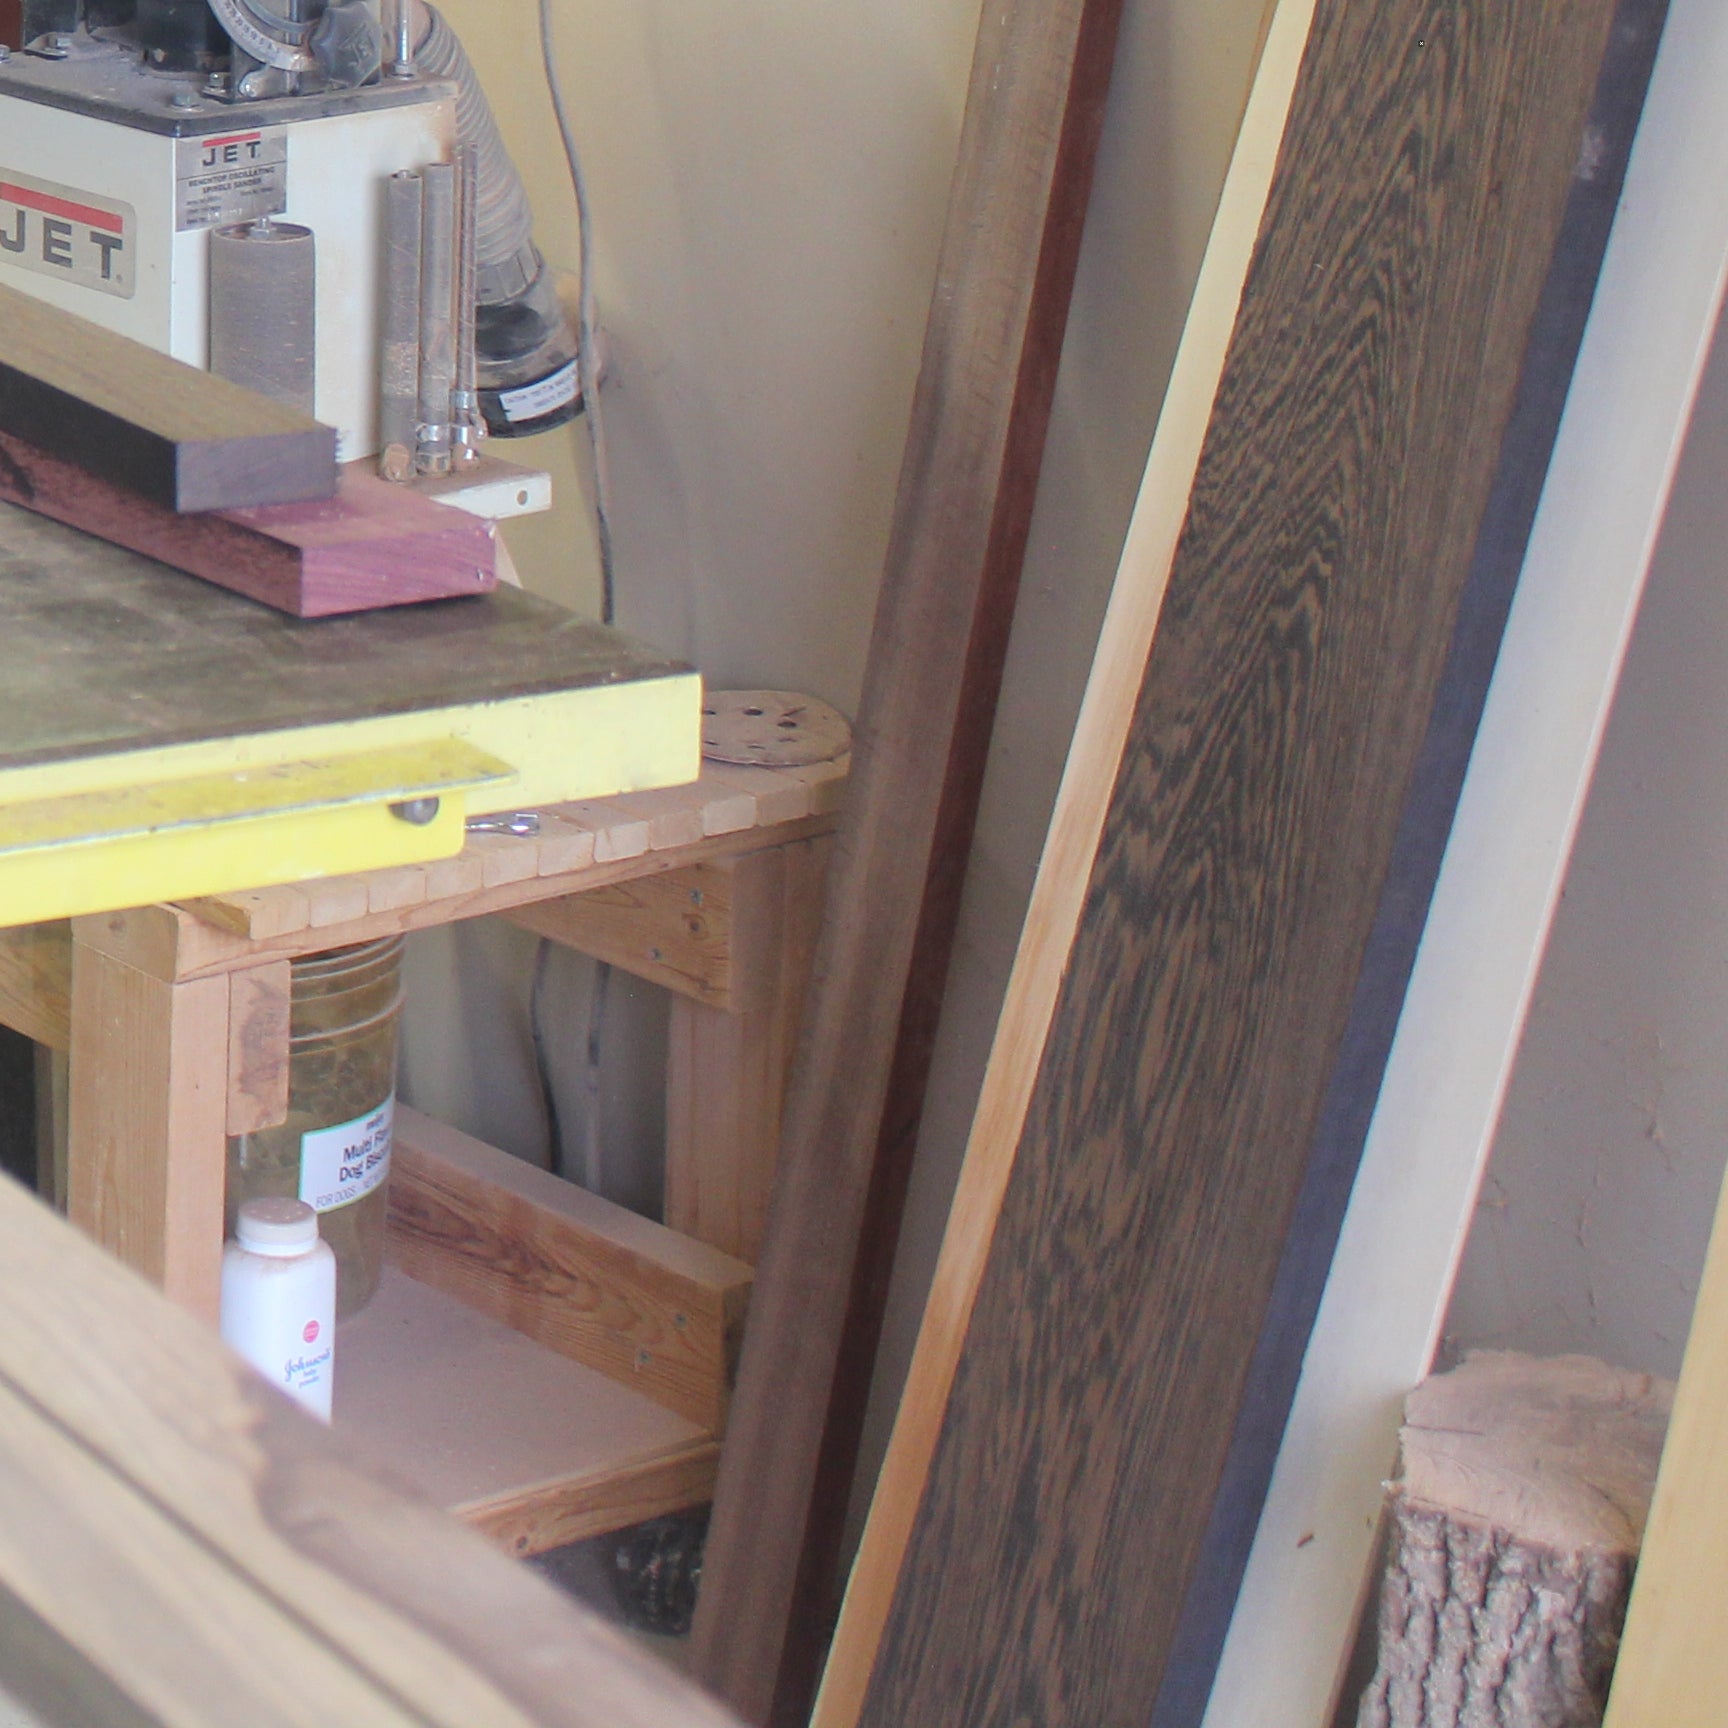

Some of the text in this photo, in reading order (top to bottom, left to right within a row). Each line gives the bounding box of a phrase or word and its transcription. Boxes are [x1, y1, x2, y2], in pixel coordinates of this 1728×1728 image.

[202, 140, 261, 166] JET
[0, 209, 124, 280] JET
[339, 1161, 364, 1183] Dog
